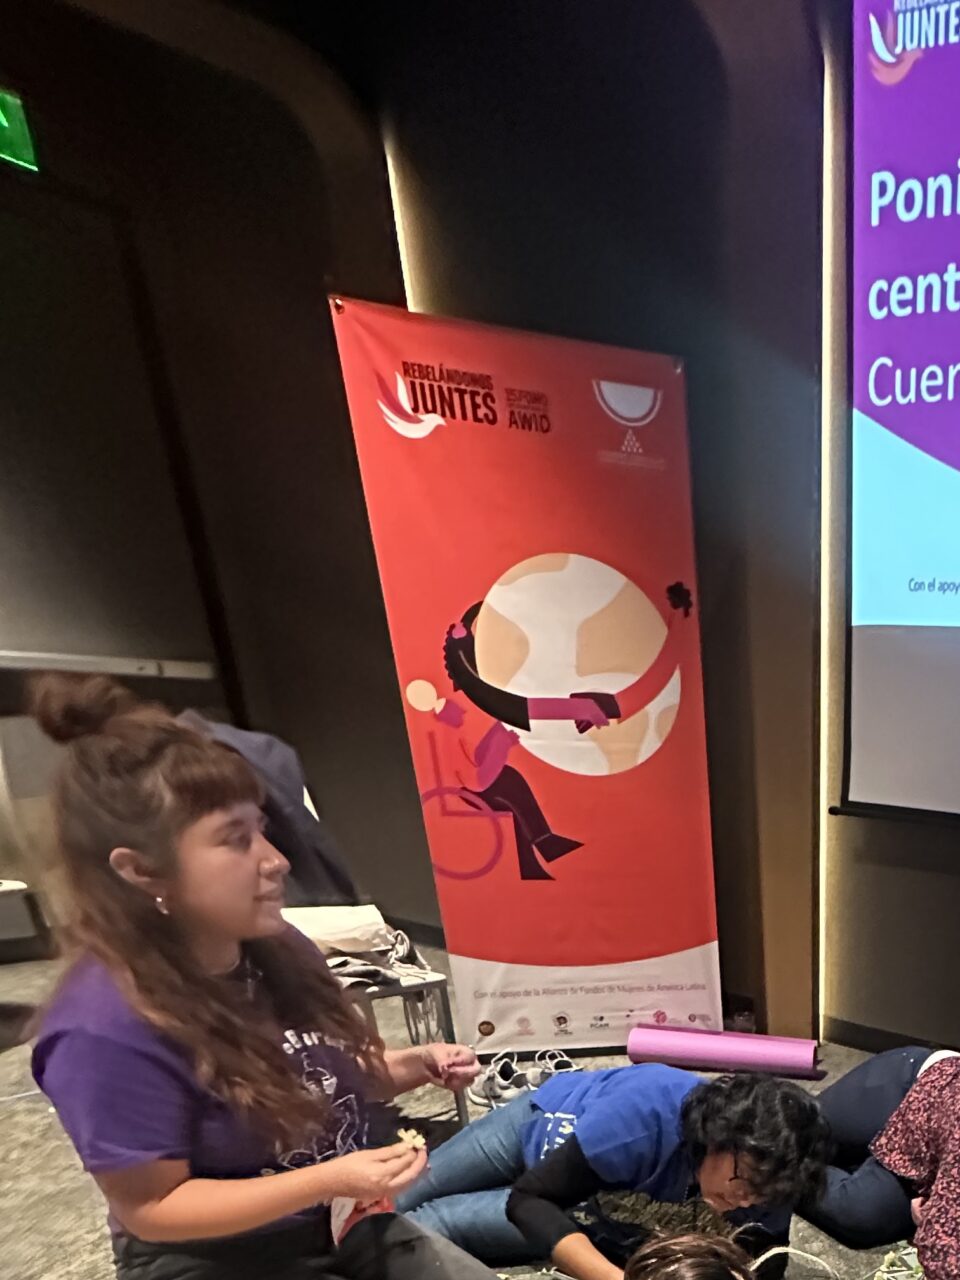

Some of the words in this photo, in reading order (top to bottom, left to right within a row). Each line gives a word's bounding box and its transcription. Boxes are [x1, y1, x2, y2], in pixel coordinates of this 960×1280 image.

[409, 380, 498, 426] JUNTES
[508, 410, 551, 434] AWID
[908, 578, 926, 592] Con
[927, 578, 936, 592] el
